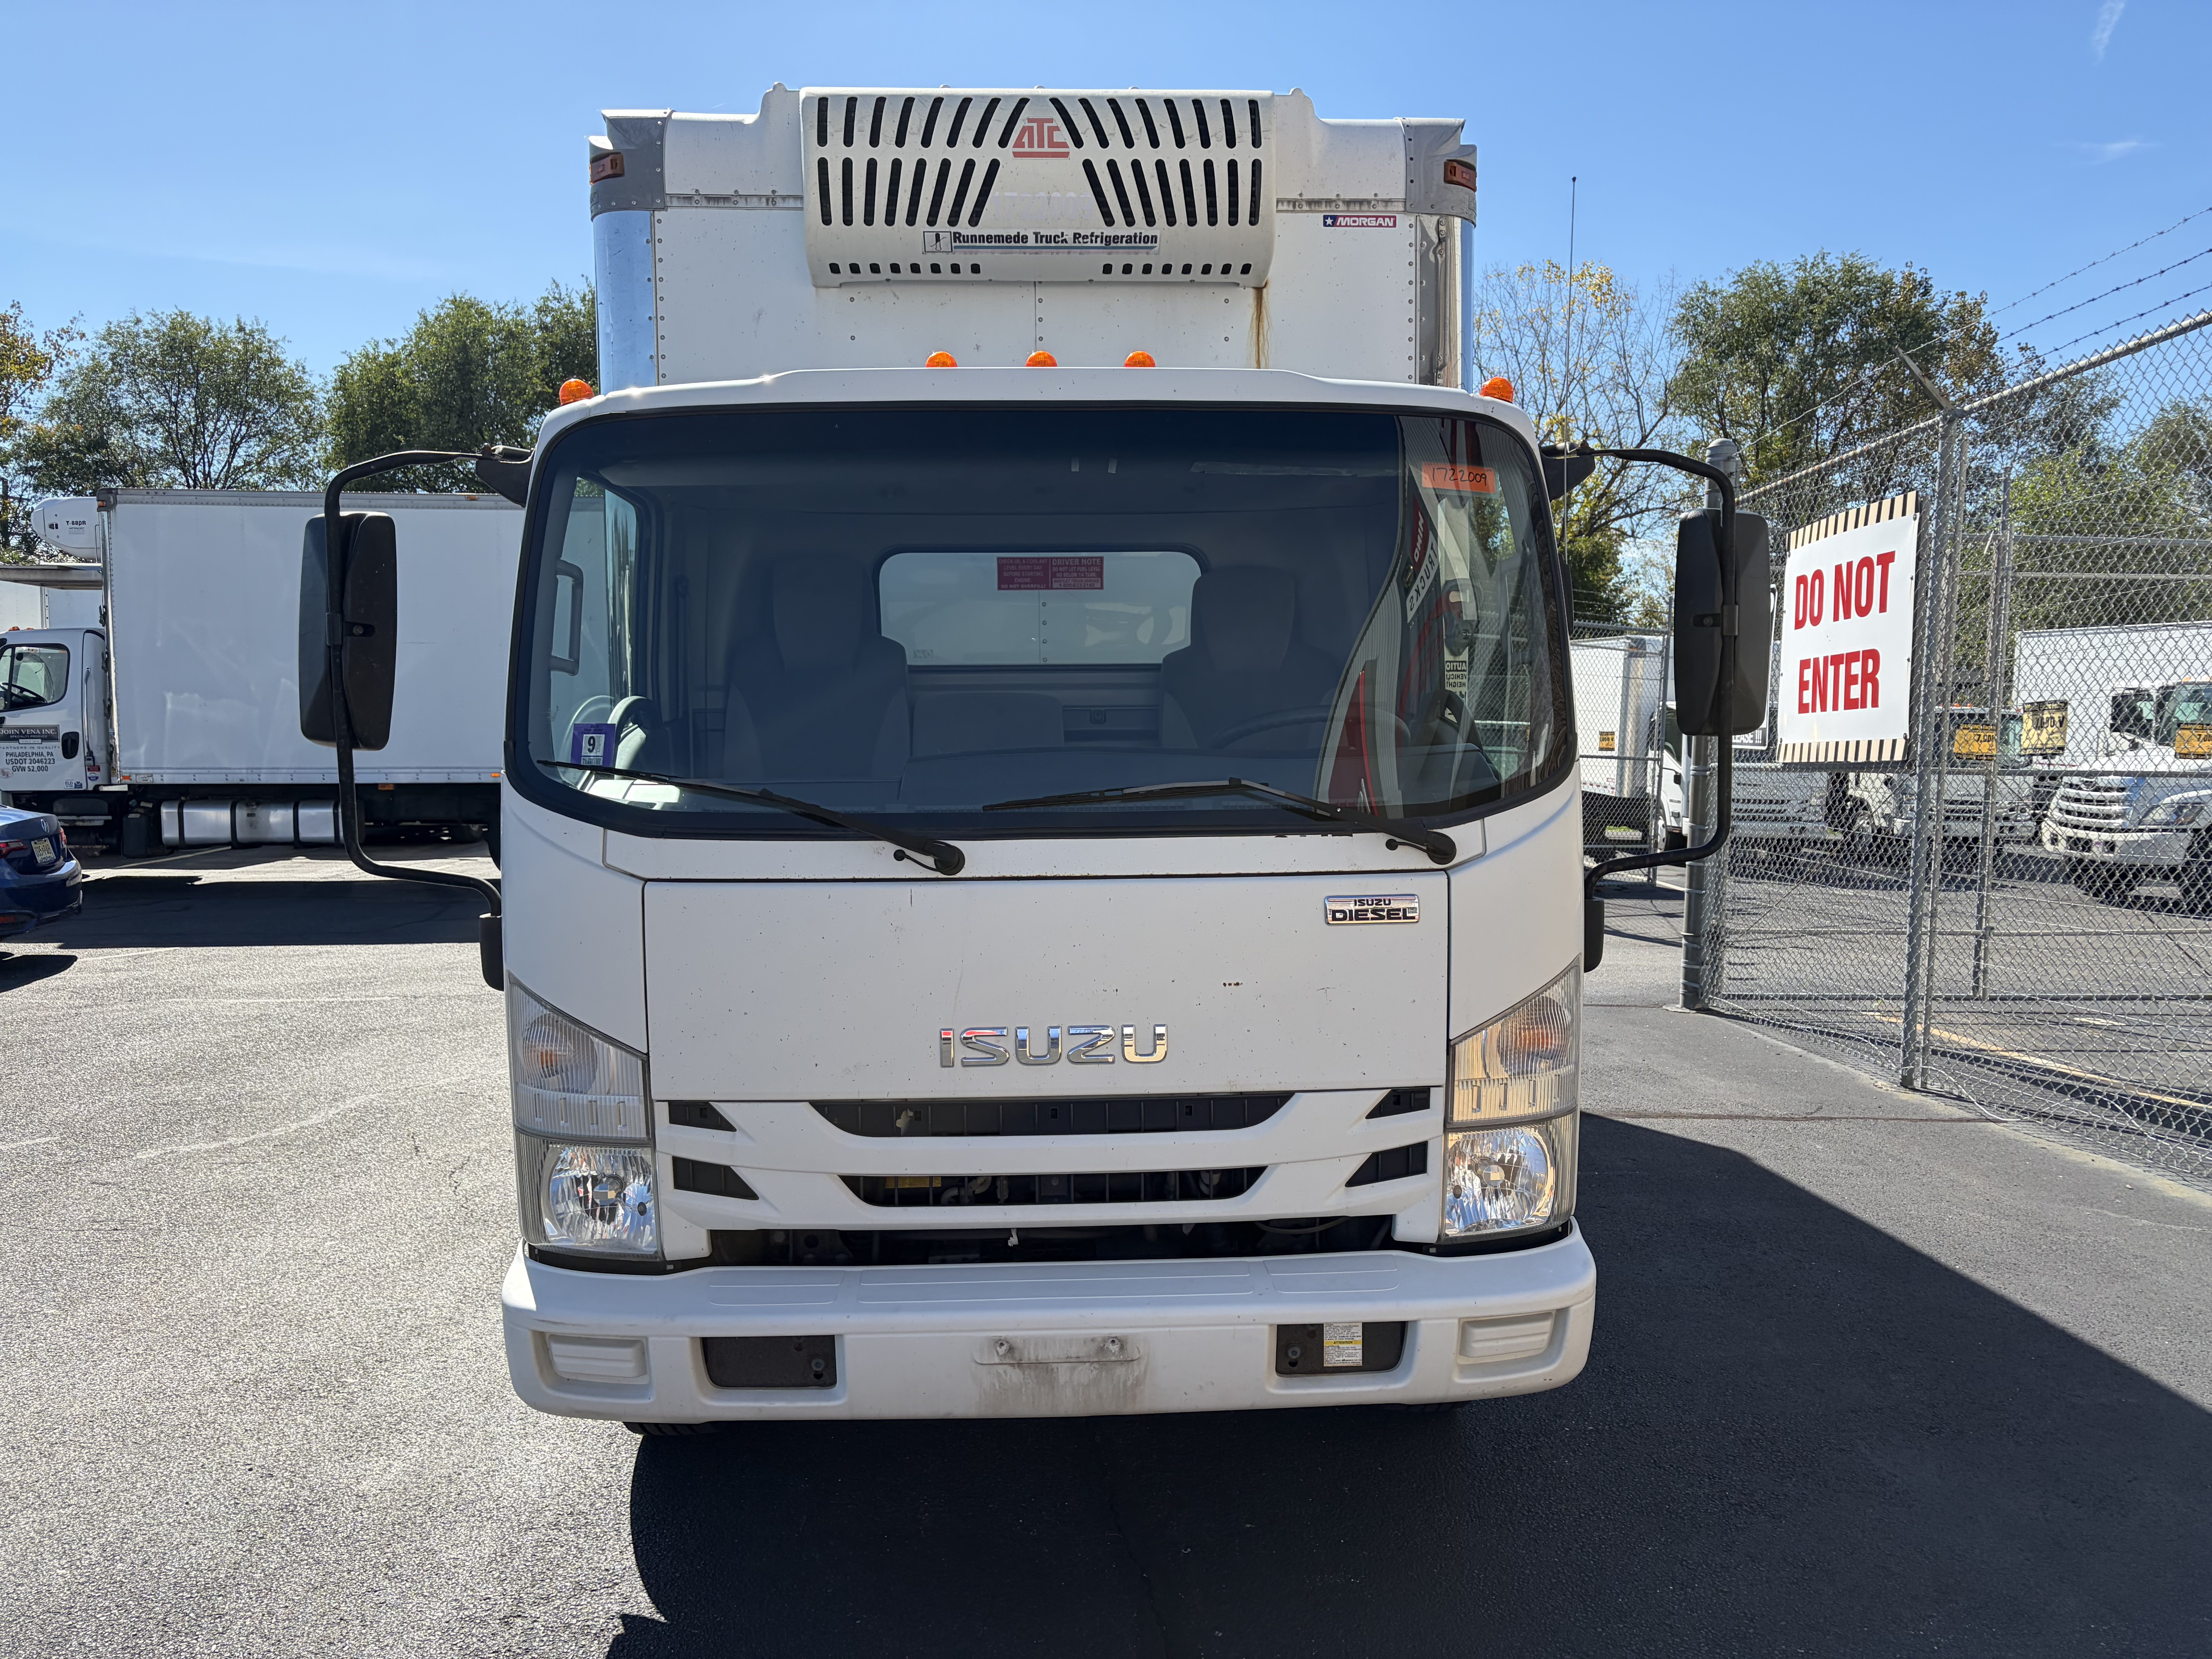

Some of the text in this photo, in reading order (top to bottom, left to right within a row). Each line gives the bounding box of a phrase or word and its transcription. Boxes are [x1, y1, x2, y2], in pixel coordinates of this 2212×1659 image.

[1012, 118, 1070, 148] ATC
[1336, 217, 1394, 227] MORGAN
[953, 232, 1158, 246] Runnemede Truck Refrigeration
[1433, 467, 1487, 486] 1722009
[1794, 550, 1896, 630] DO NOT
[1798, 648, 1880, 714] ENTER
[587, 736, 596, 753] 9
[1354, 898, 1391, 907] ISUZU
[1331, 908, 1416, 921] DIESEL
[939, 1024, 1168, 1067] ISUZU
